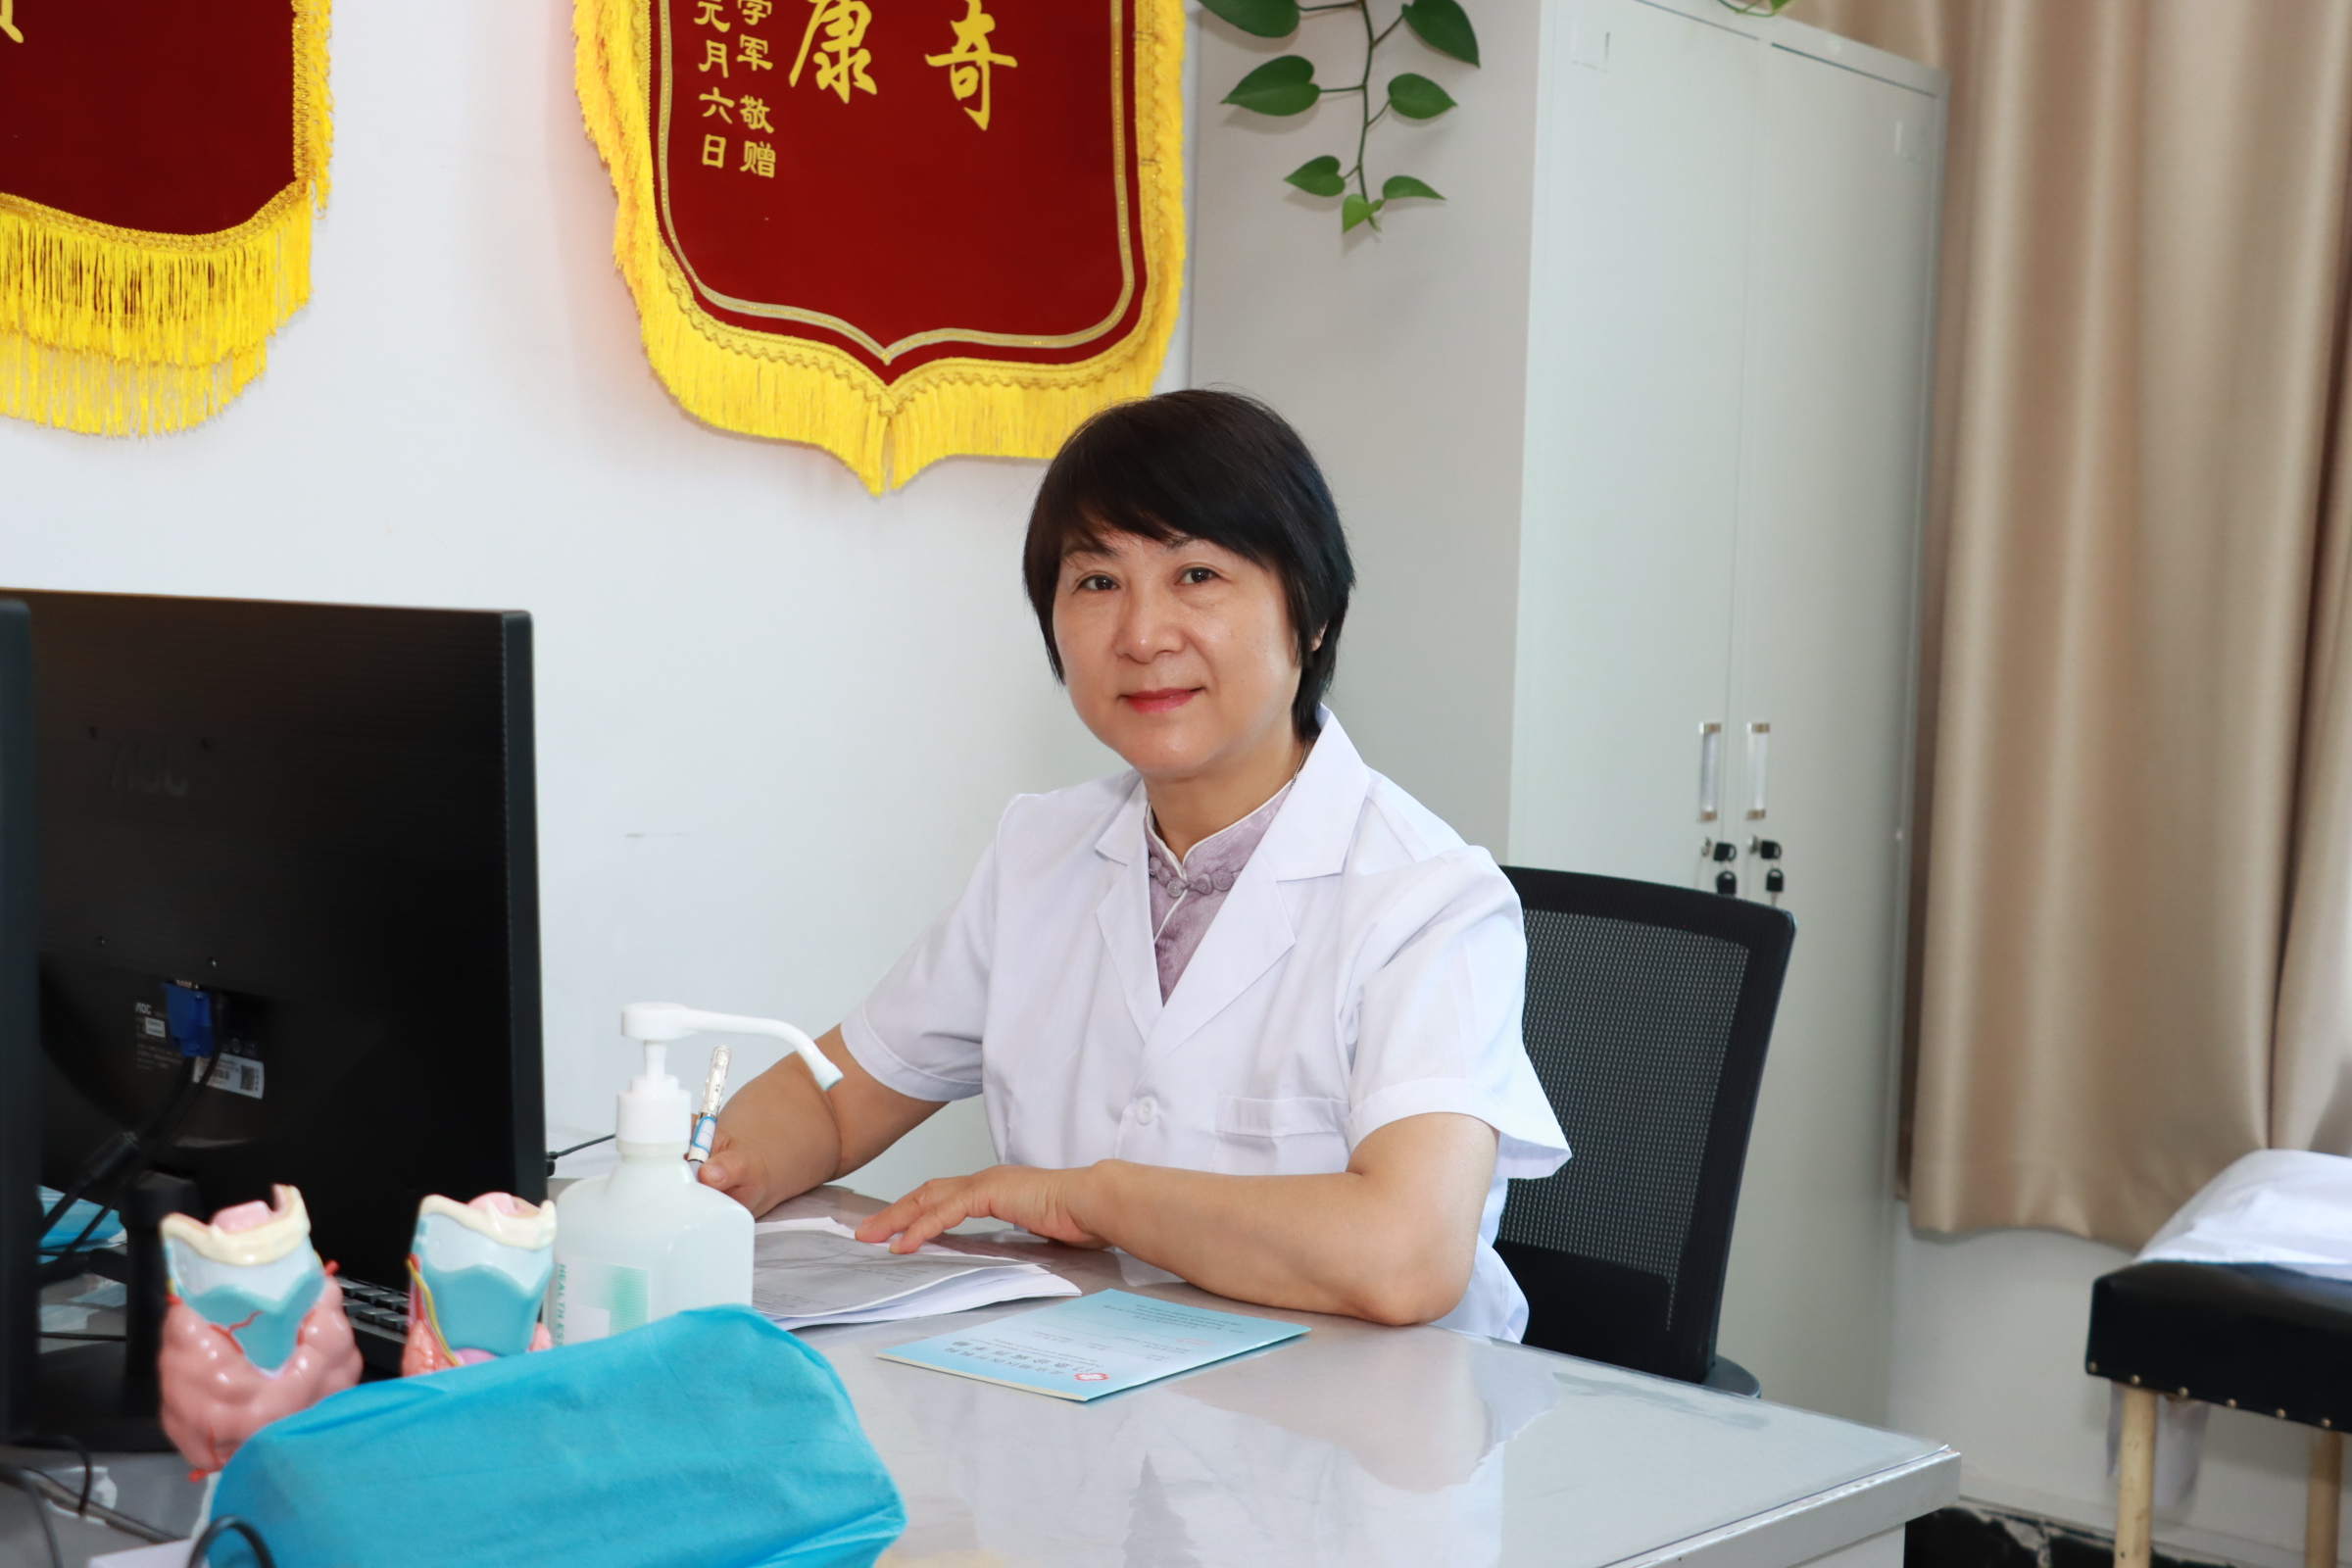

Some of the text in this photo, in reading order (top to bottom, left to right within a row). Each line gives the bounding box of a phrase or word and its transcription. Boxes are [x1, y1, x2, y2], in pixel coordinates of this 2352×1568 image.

[789, 0, 878, 105] 康
[694, 0, 735, 169] 元月六日
[112, 742, 189, 798] AOC
[135, 1002, 152, 1015] AOC
[558, 1262, 567, 1319] HEALTH
